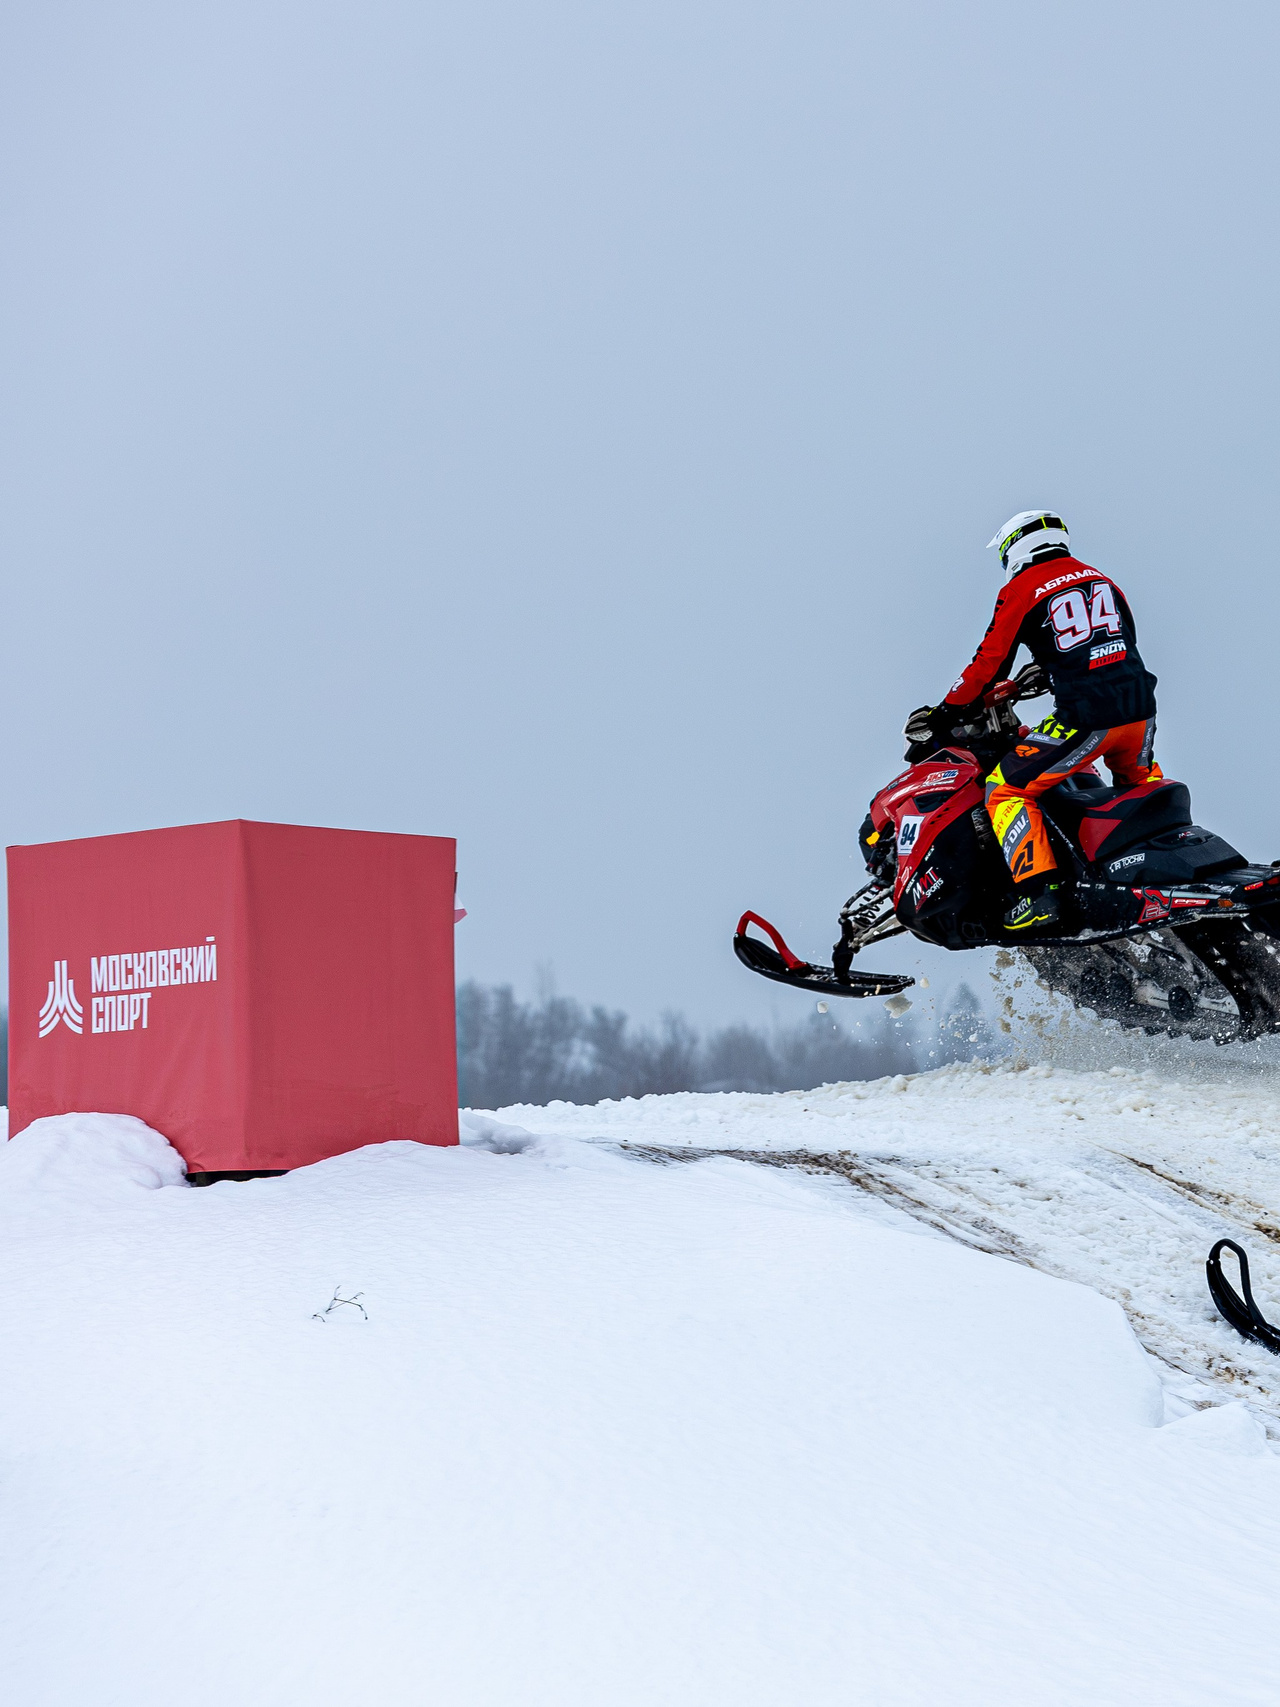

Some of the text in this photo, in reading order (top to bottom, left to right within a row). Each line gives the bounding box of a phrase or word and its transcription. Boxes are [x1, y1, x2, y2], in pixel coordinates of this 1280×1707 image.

[1046, 581, 1121, 652] 94
[900, 823, 917, 846] 94
[925, 877, 944, 898] SPORTS
[1011, 898, 1029, 919] FXR
[91, 936, 217, 993] МОСКОВСКИЙ
[91, 992, 151, 1034] СПОРТ
